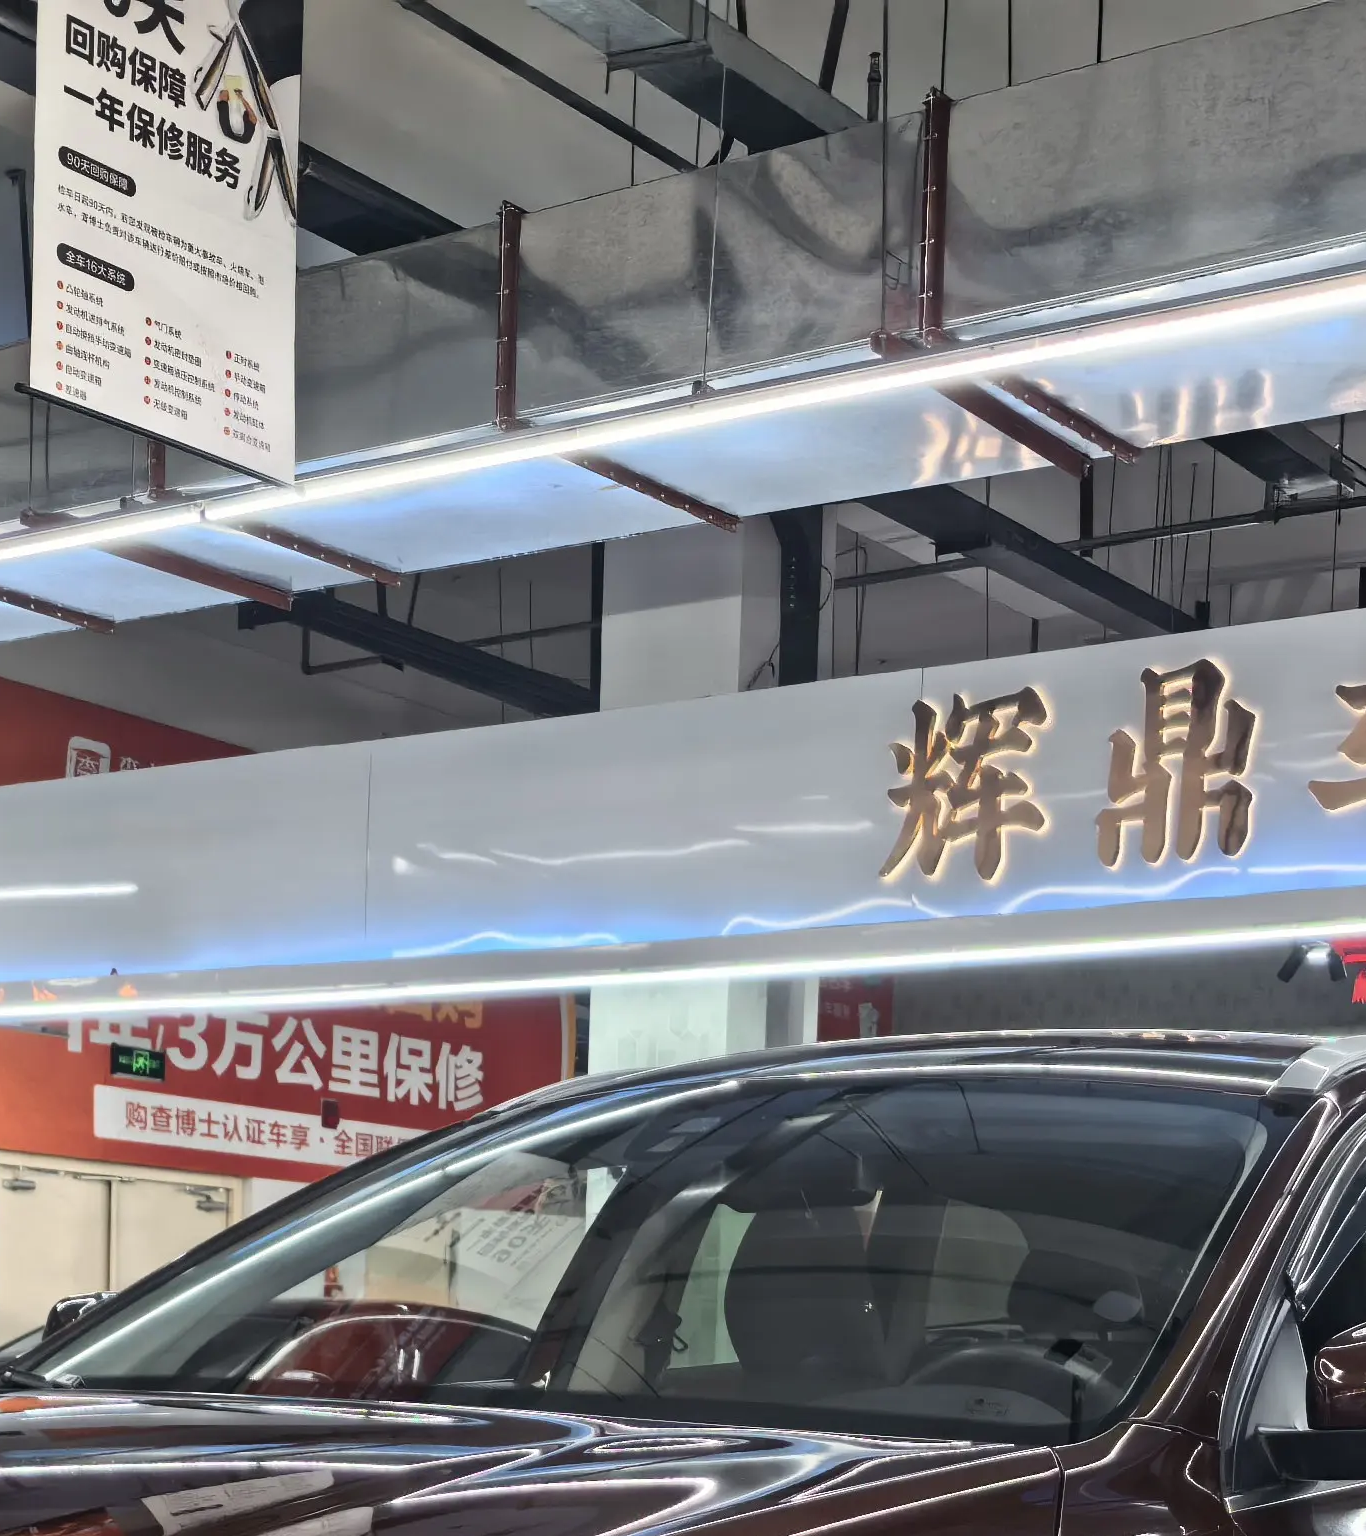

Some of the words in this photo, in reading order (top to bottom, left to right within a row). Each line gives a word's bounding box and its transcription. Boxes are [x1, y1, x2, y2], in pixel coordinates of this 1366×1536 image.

[65, 14, 186, 108] 回购保障
[63, 84, 241, 189] 一年保修服务
[66, 152, 129, 190] 90天回购保障
[66, 250, 126, 286] 全车16大系统
